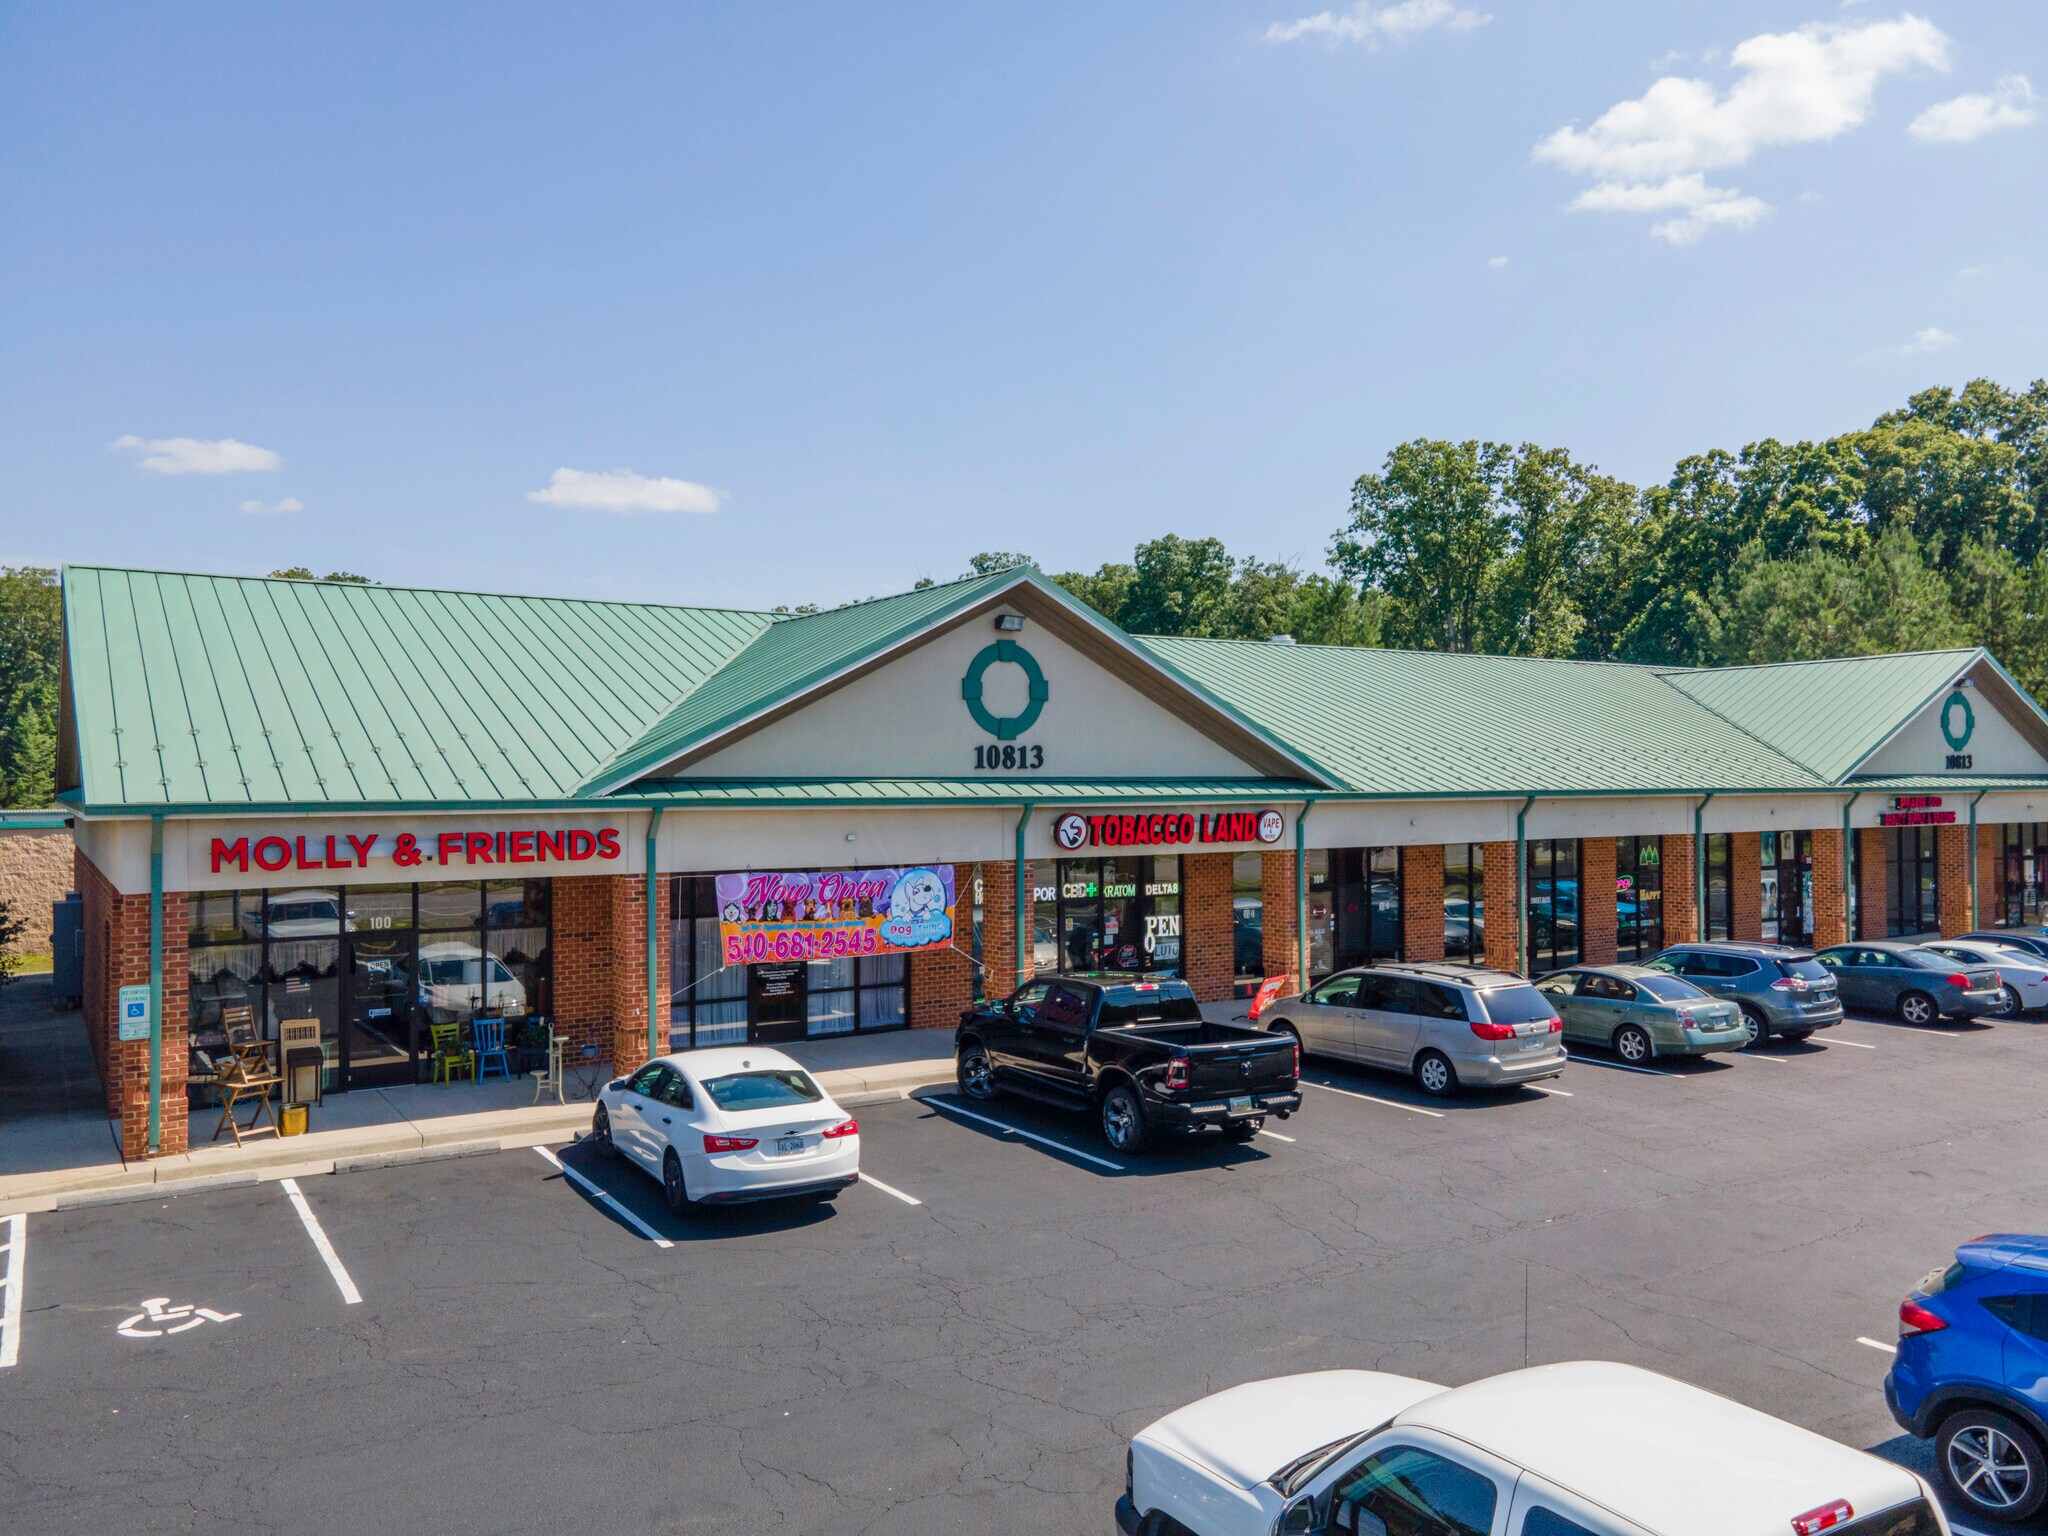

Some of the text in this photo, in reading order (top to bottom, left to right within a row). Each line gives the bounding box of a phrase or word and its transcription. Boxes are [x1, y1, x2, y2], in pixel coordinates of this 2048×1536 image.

[974, 744, 1044, 769] 10813
[1087, 812, 1258, 847] TOBACCO LAND
[1262, 817, 1280, 829] VAPE
[211, 828, 621, 873] MOLLY & FRIENDS
[742, 873, 888, 908] Now Open
[1145, 883, 1179, 896] DELTA8
[369, 917, 391, 930] 100
[728, 927, 878, 962] 540-681-2545
[369, 960, 390, 970] OPEN
